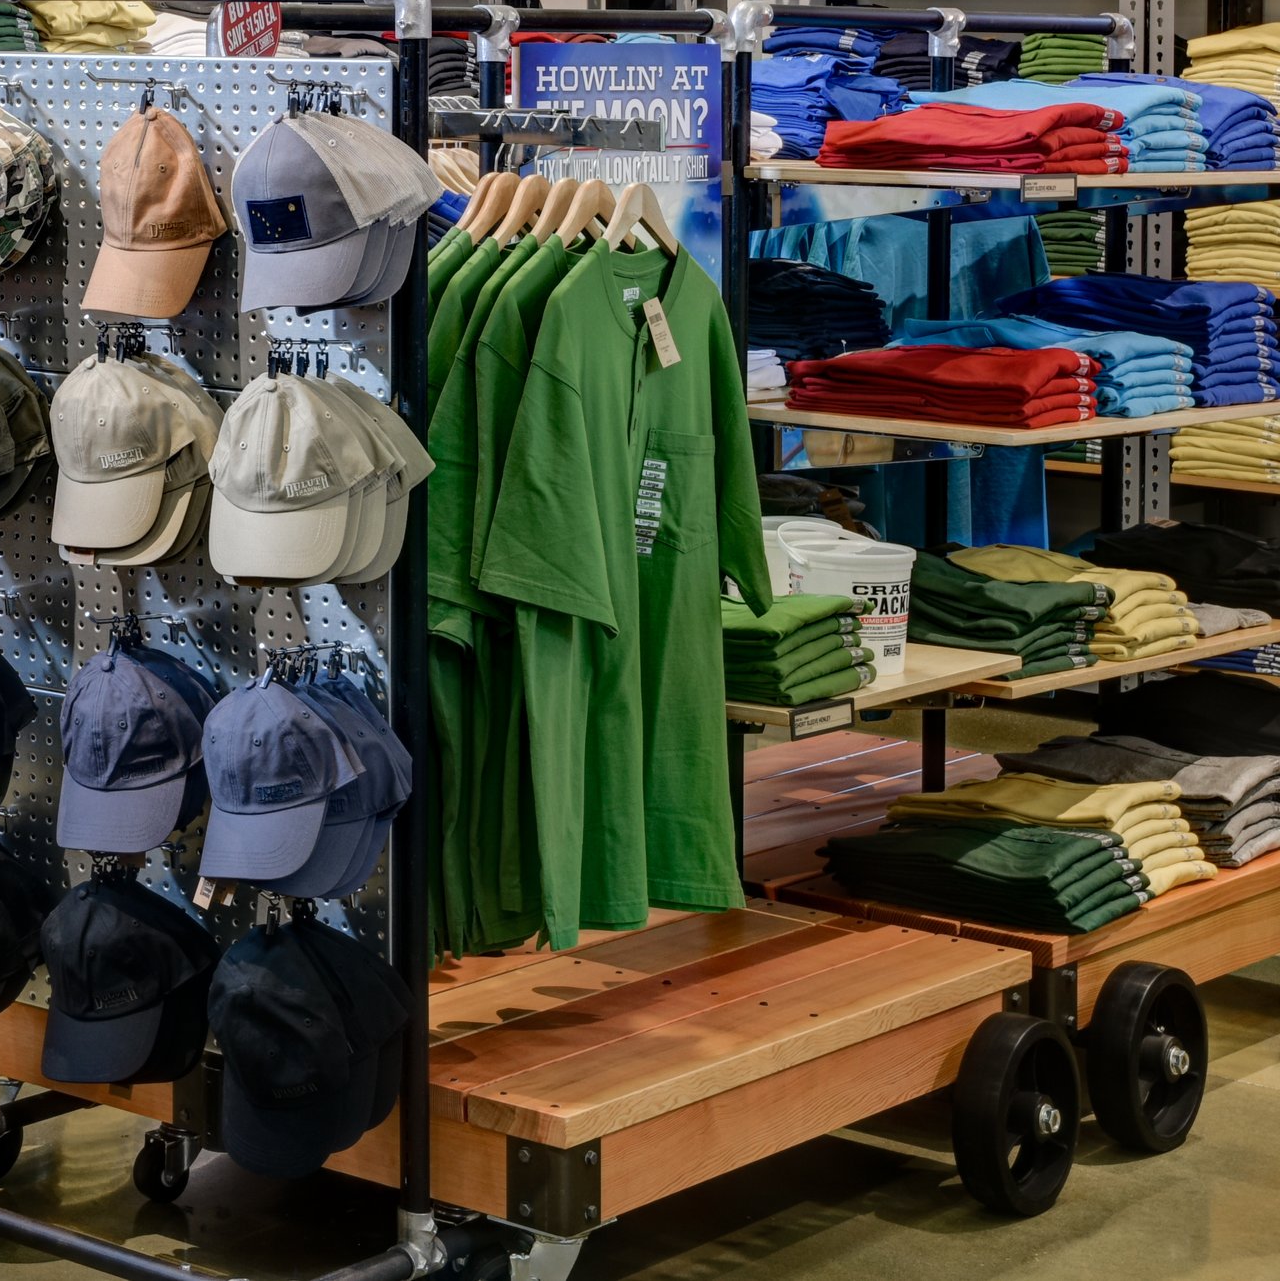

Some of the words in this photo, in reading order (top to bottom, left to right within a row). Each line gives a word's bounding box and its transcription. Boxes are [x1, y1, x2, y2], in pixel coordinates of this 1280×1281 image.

[226, 21, 248, 52] SAVE
[536, 65, 664, 92] HOWLIN'
[671, 66, 708, 91] AT
[672, 155, 682, 182] T
[686, 154, 709, 179] SHIRT
[99, 447, 145, 469] DULUTH
[285, 474, 330, 498] DULUTH
